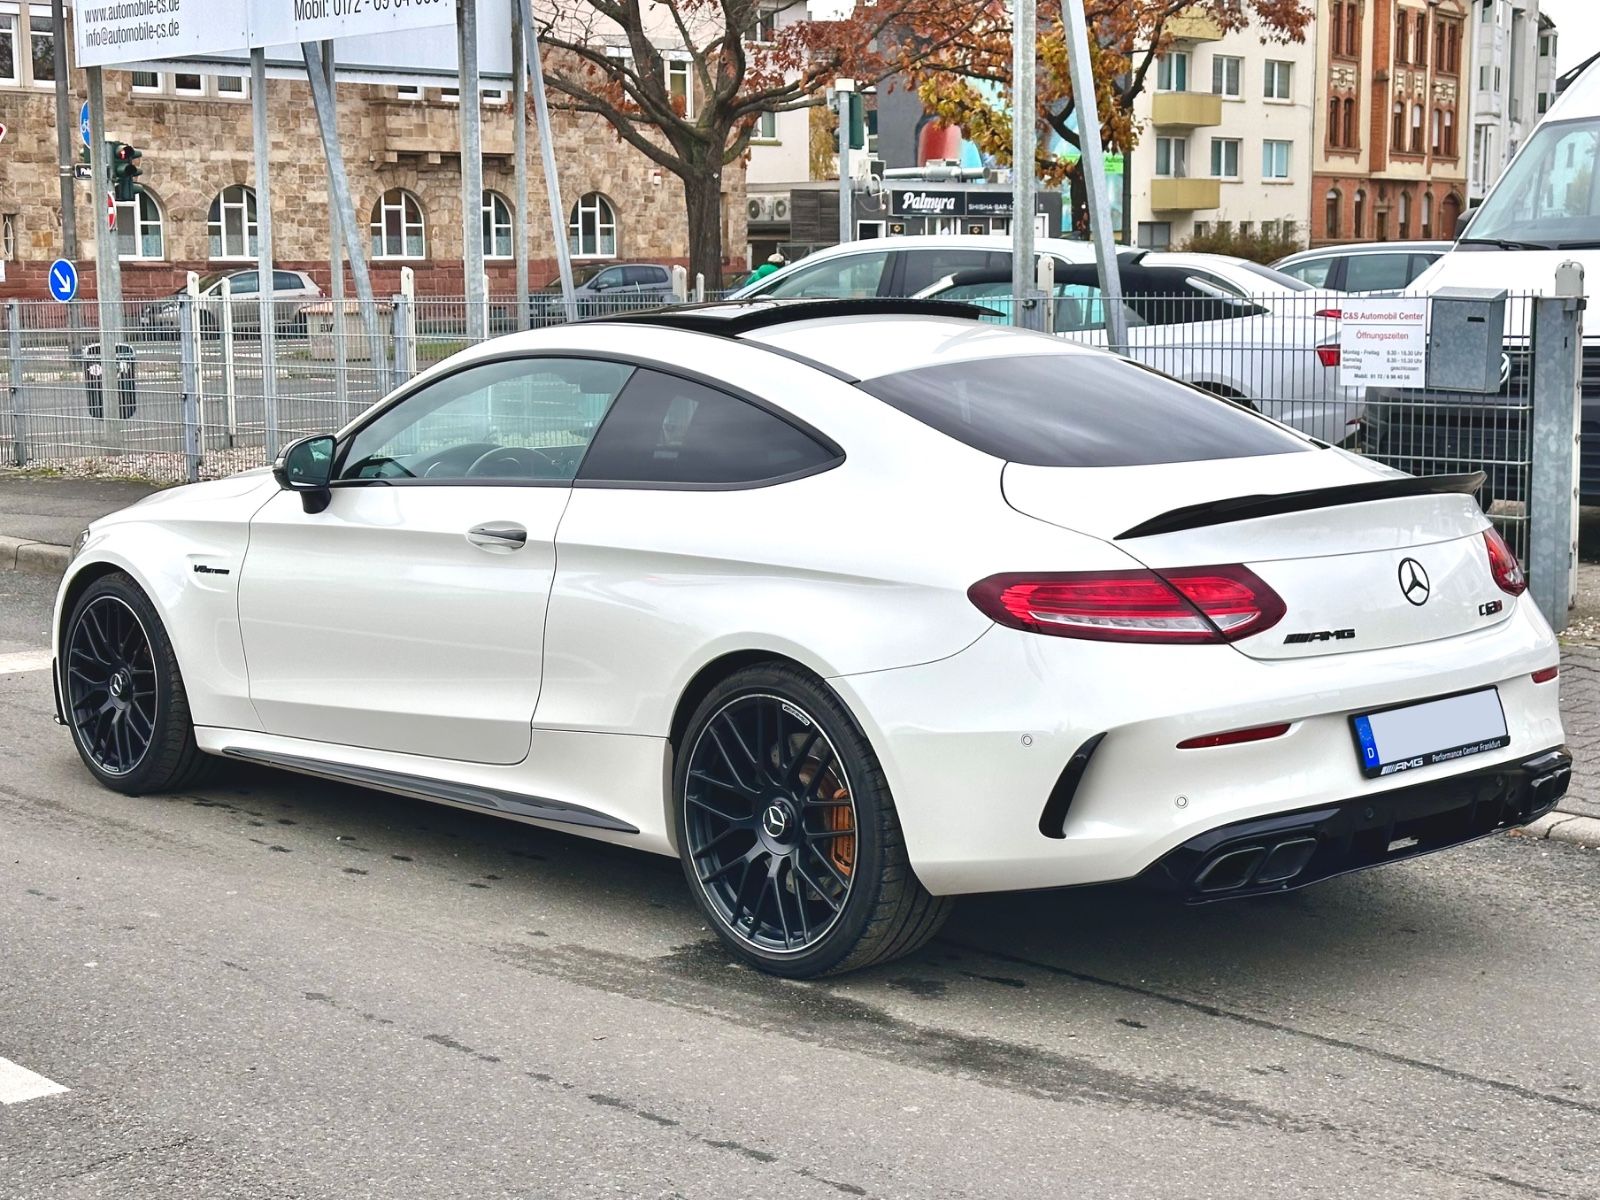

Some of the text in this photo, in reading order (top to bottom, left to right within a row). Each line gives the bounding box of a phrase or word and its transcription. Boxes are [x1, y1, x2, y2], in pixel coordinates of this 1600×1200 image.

[84, 0, 180, 23] www.automobile-cs.de
[294, 0, 329, 21] Mobil:
[85, 18, 180, 47] info@automobile-cs.de
[903, 191, 956, 213] Palmyra
[1343, 312, 1424, 320] C&S Automobil Center
[1356, 330, 1409, 341] Öffnungszeiten
[1306, 628, 1356, 642] AMG
[1367, 747, 1375, 759] D
[1394, 740, 1501, 772] AMG Performance Center Frankfurt
